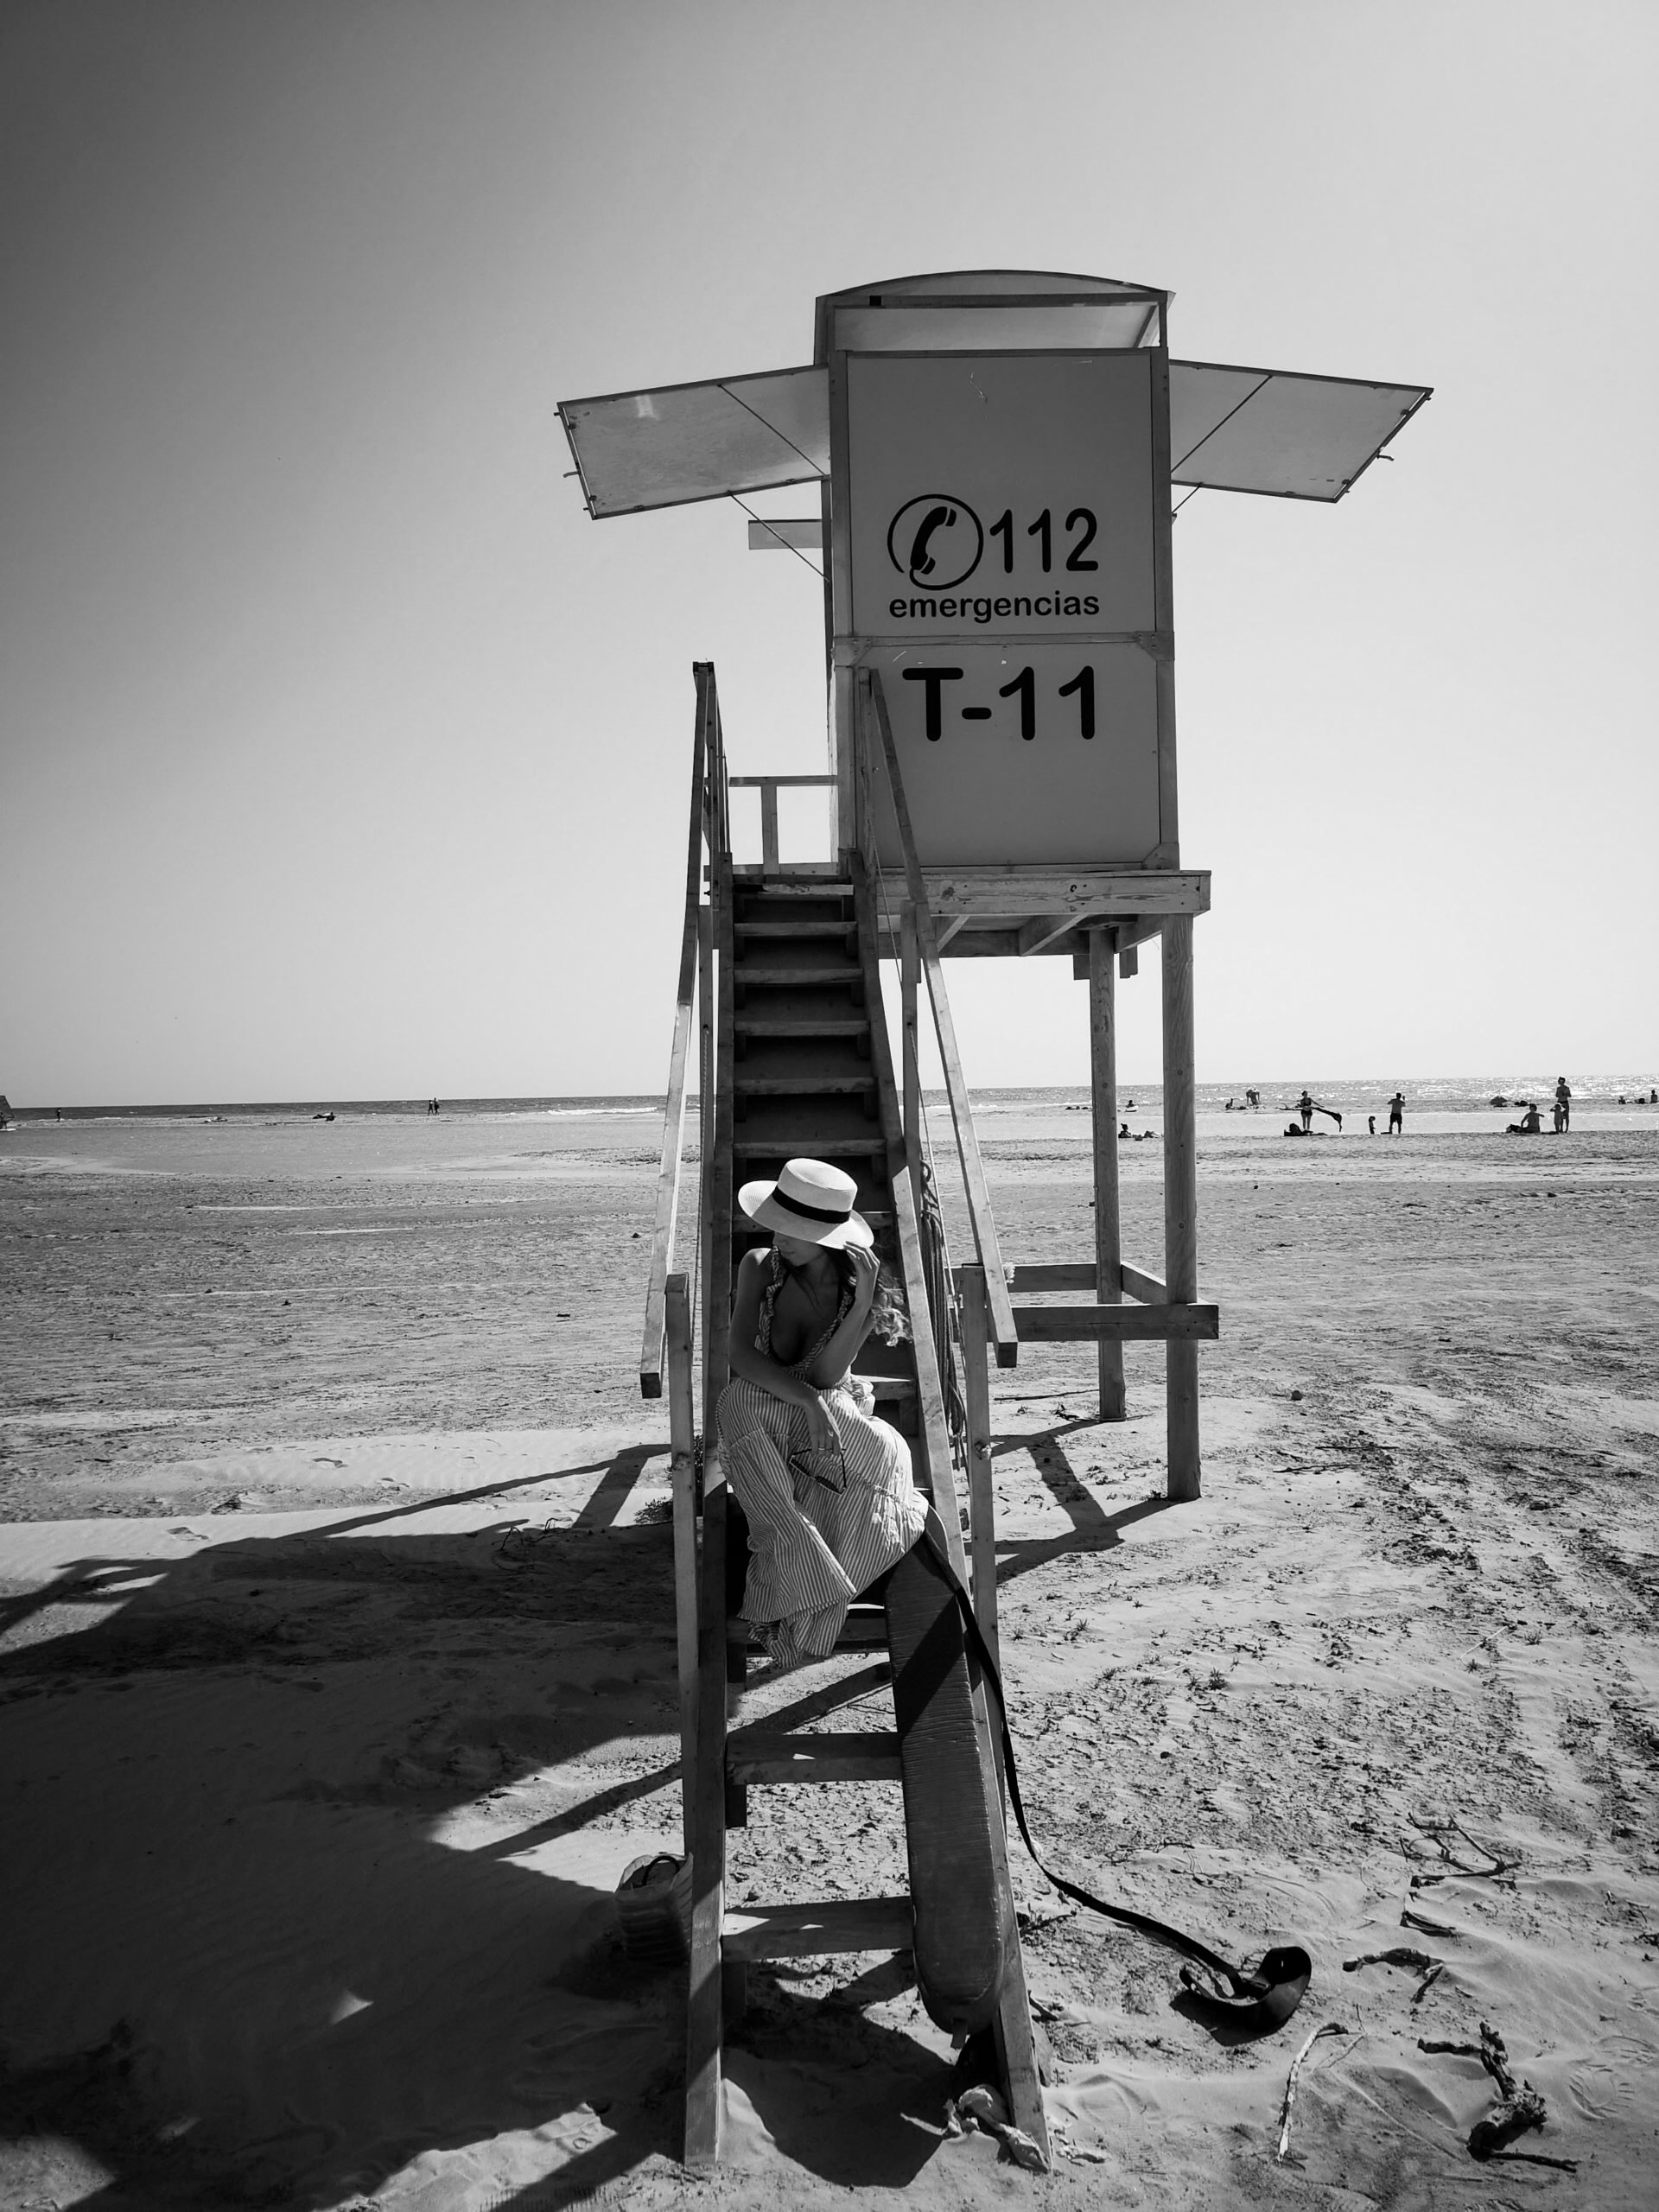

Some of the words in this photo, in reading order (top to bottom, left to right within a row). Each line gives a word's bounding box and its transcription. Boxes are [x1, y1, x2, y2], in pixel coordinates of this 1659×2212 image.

[989, 508, 1099, 574] 112
[888, 590, 1100, 624] emergencias
[902, 665, 1096, 742] T-11
